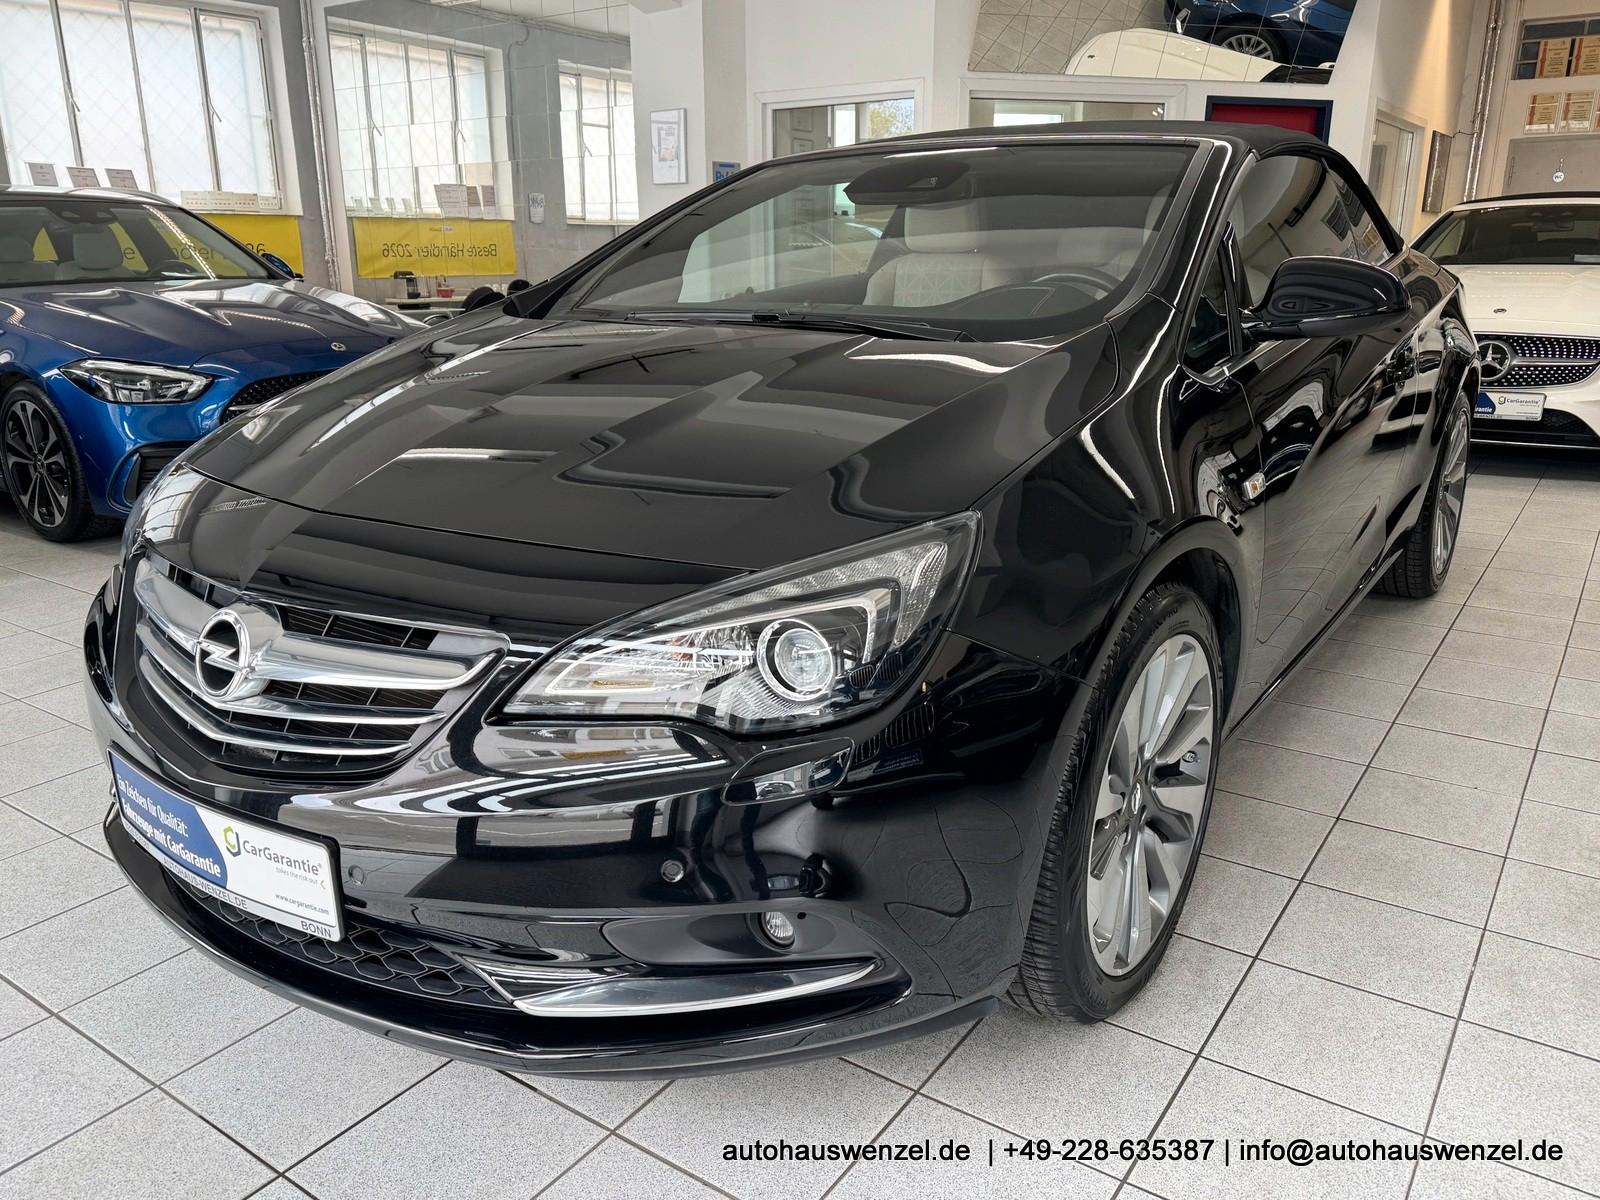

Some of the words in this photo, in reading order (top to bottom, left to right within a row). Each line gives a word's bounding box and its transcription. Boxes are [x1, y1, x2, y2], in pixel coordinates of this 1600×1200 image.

[157, 805, 189, 838] Qualität:
[154, 826, 167, 848] mit
[167, 835, 221, 877] CarGarantie
[163, 857, 248, 909] AUTOHAUS-WENZEL.DE
[275, 893, 330, 916] www.cargarantie.com
[301, 920, 332, 939] BONN
